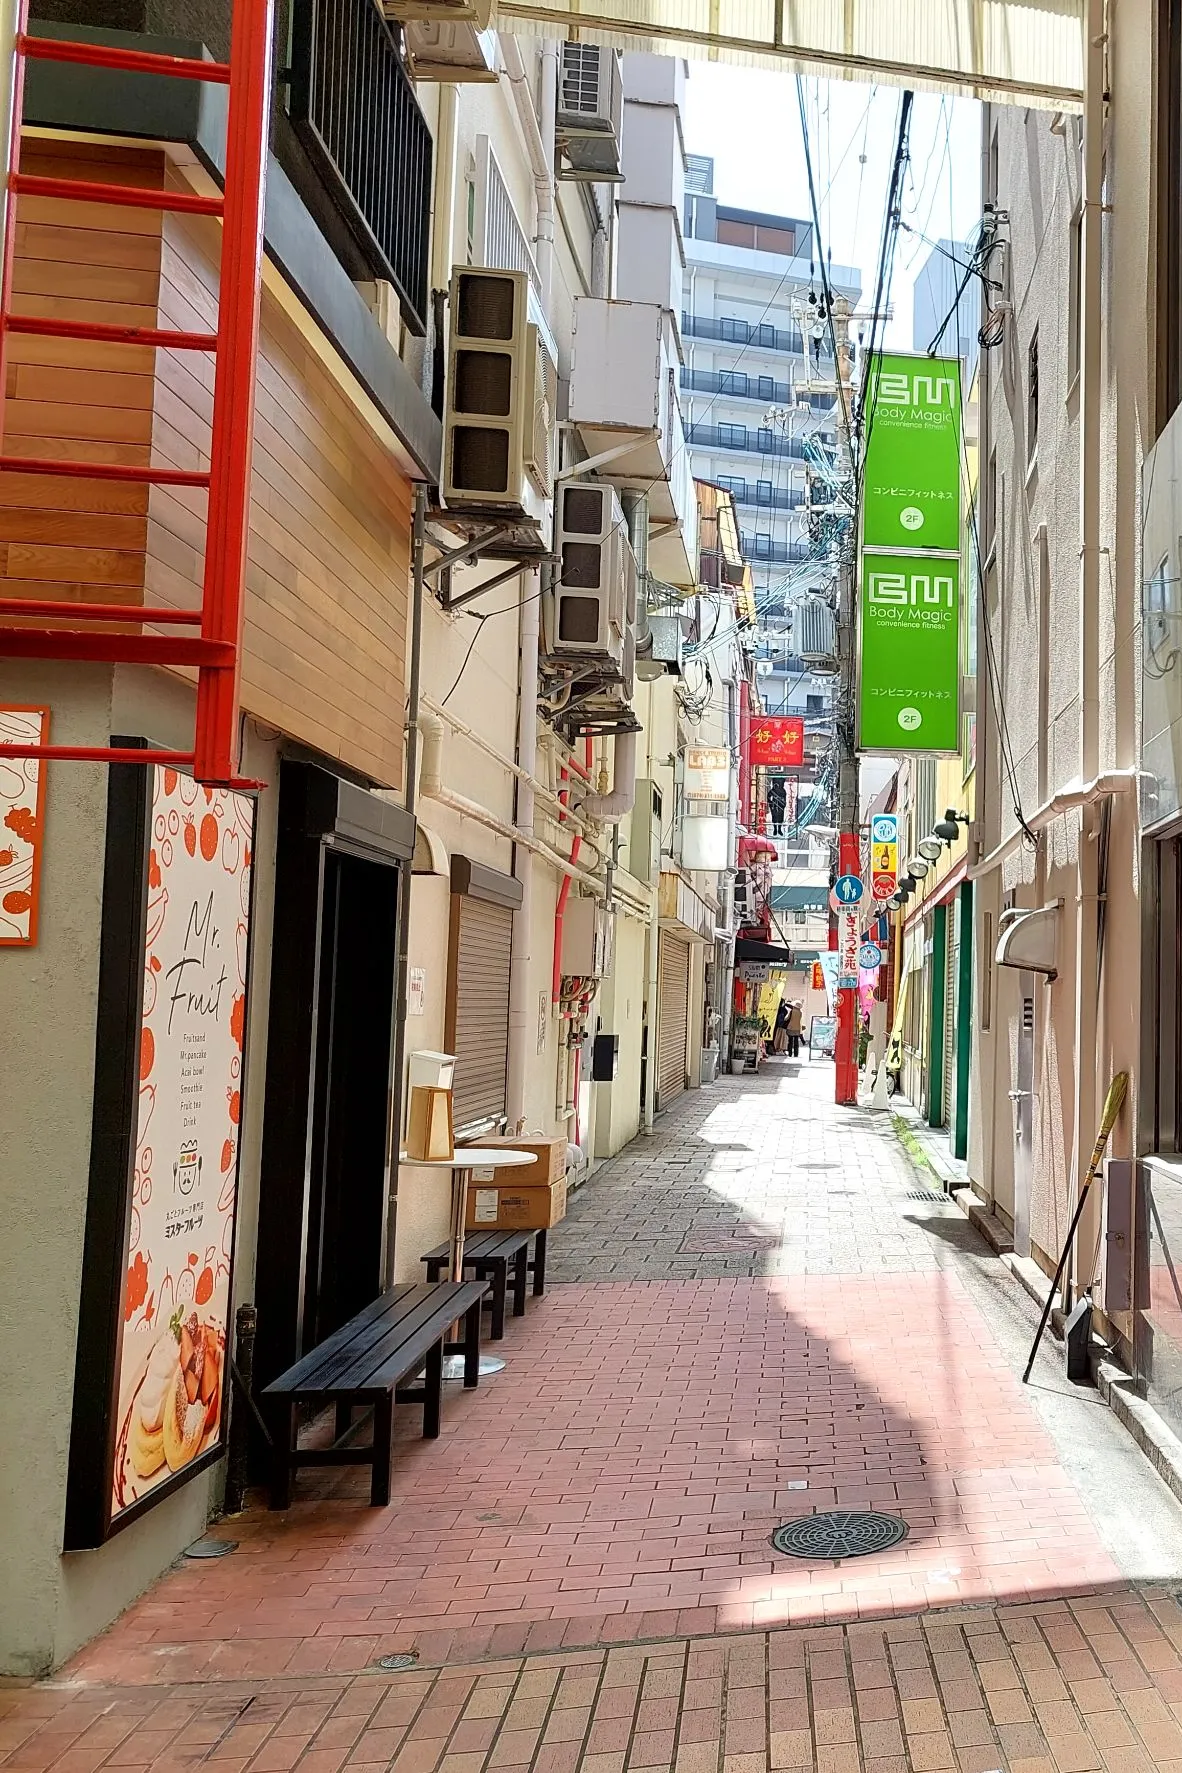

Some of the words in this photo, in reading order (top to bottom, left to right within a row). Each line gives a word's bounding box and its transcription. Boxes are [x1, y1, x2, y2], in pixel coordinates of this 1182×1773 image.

[911, 409, 954, 424] Magic
[873, 486, 953, 499] コンビニフィットネス
[906, 514, 919, 523] 2F
[869, 606, 904, 621] Body
[909, 609, 952, 624] Magic
[876, 620, 921, 629] convenience
[922, 621, 946, 630] fitness
[871, 687, 952, 699] コンビニフィットネス
[903, 714, 917, 723] 2F
[184, 890, 219, 968] Mr.
[166, 957, 228, 1035] Fruit
[165, 1214, 203, 1238] ミスターフルーツ
